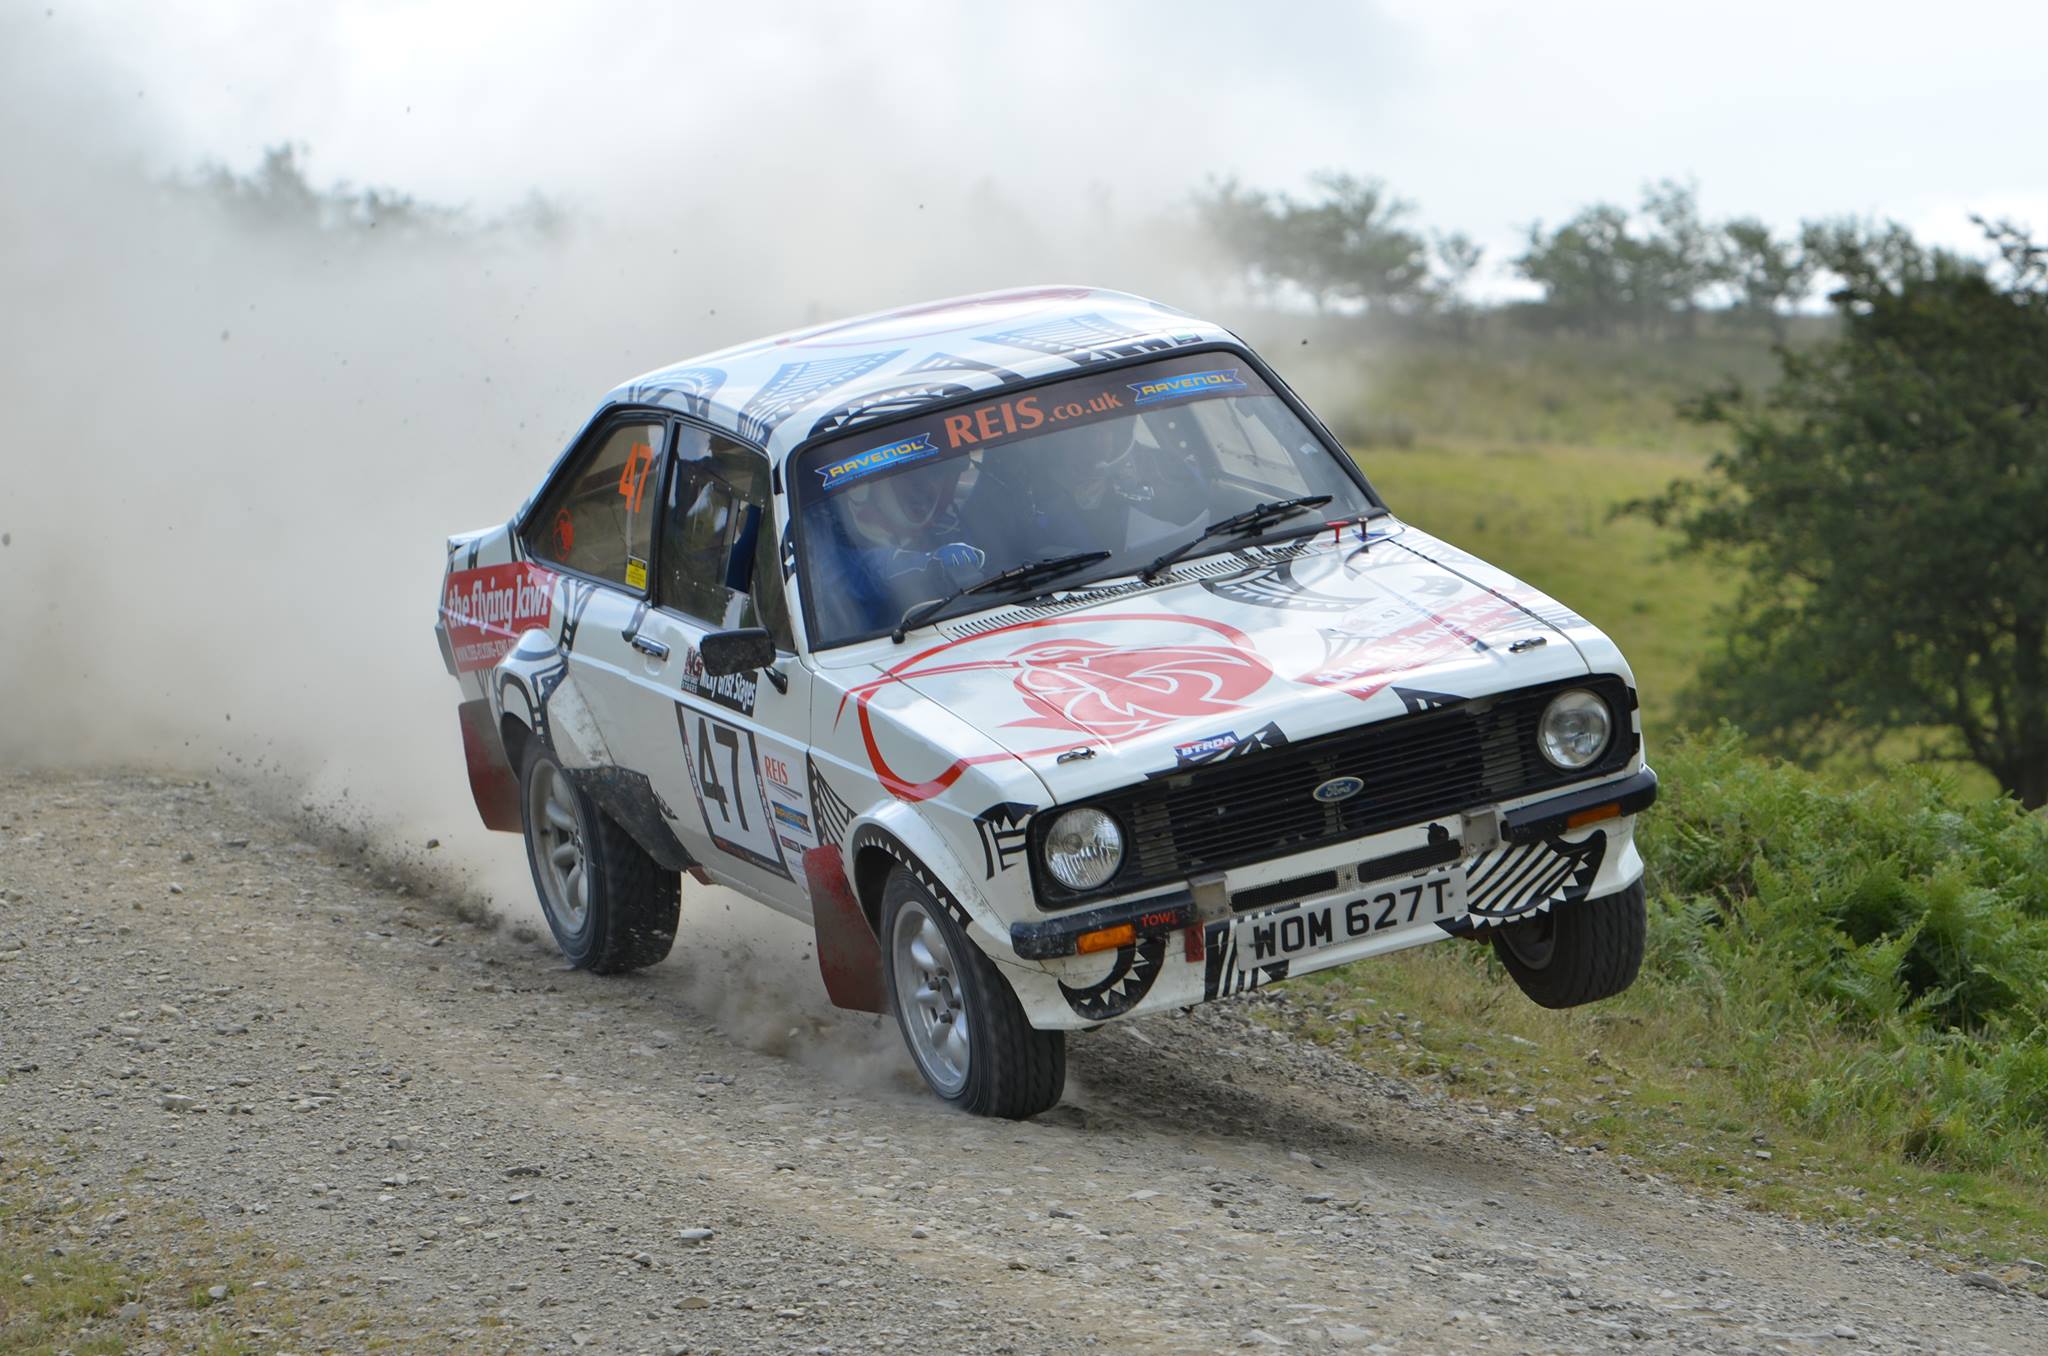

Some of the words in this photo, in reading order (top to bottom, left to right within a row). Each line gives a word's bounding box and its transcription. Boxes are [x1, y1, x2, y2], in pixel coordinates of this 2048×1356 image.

[1141, 374, 1233, 395] RAVENOL
[619, 442, 653, 512] 47
[829, 441, 925, 477] RAVENOL
[449, 584, 469, 629] the
[471, 576, 513, 635] flying
[515, 573, 554, 618] kiwi
[764, 755, 789, 785] REIS
[1179, 735, 1237, 756] BTRDA
[698, 717, 749, 832] 47
[1253, 907, 1333, 960] WOM
[1345, 878, 1450, 937] 627T
